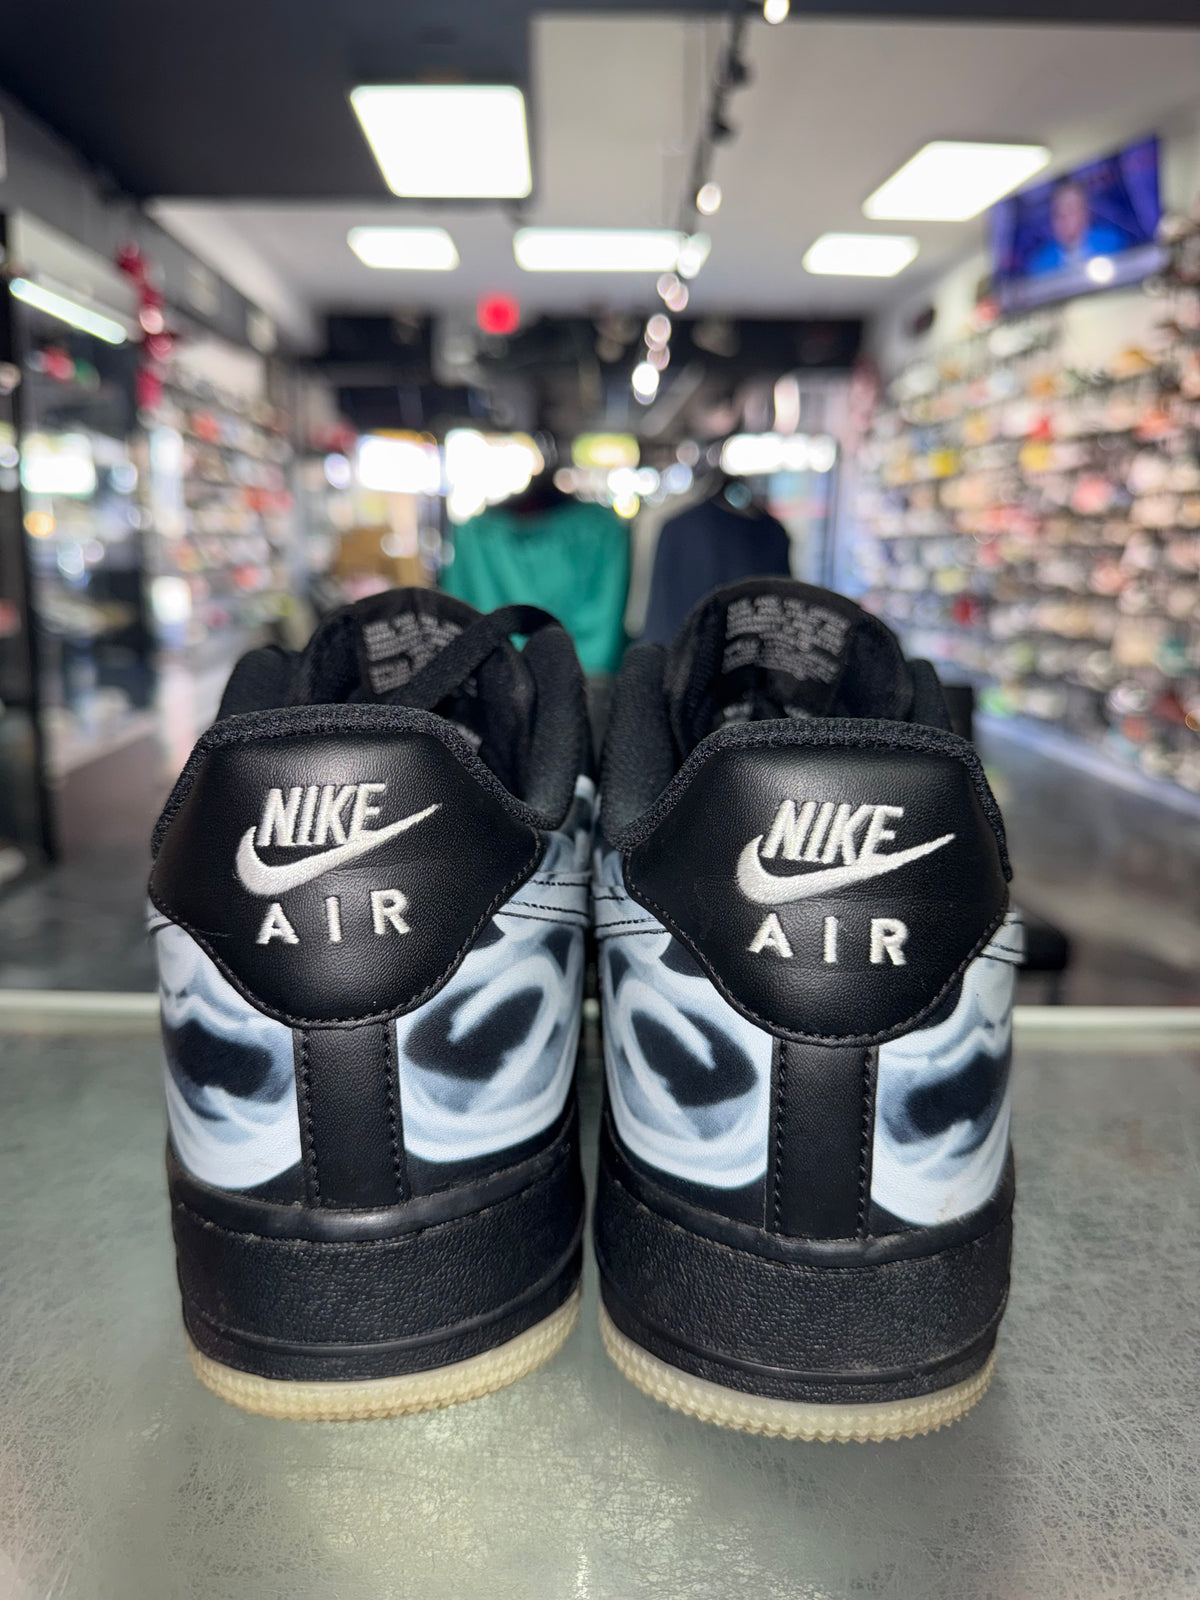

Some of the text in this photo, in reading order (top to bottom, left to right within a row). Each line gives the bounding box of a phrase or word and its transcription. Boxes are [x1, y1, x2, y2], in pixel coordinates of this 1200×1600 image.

[256, 783, 386, 847] NIKE
[760, 799, 905, 865] NIKE
[256, 888, 410, 944] AIR
[749, 912, 909, 965] AIR
